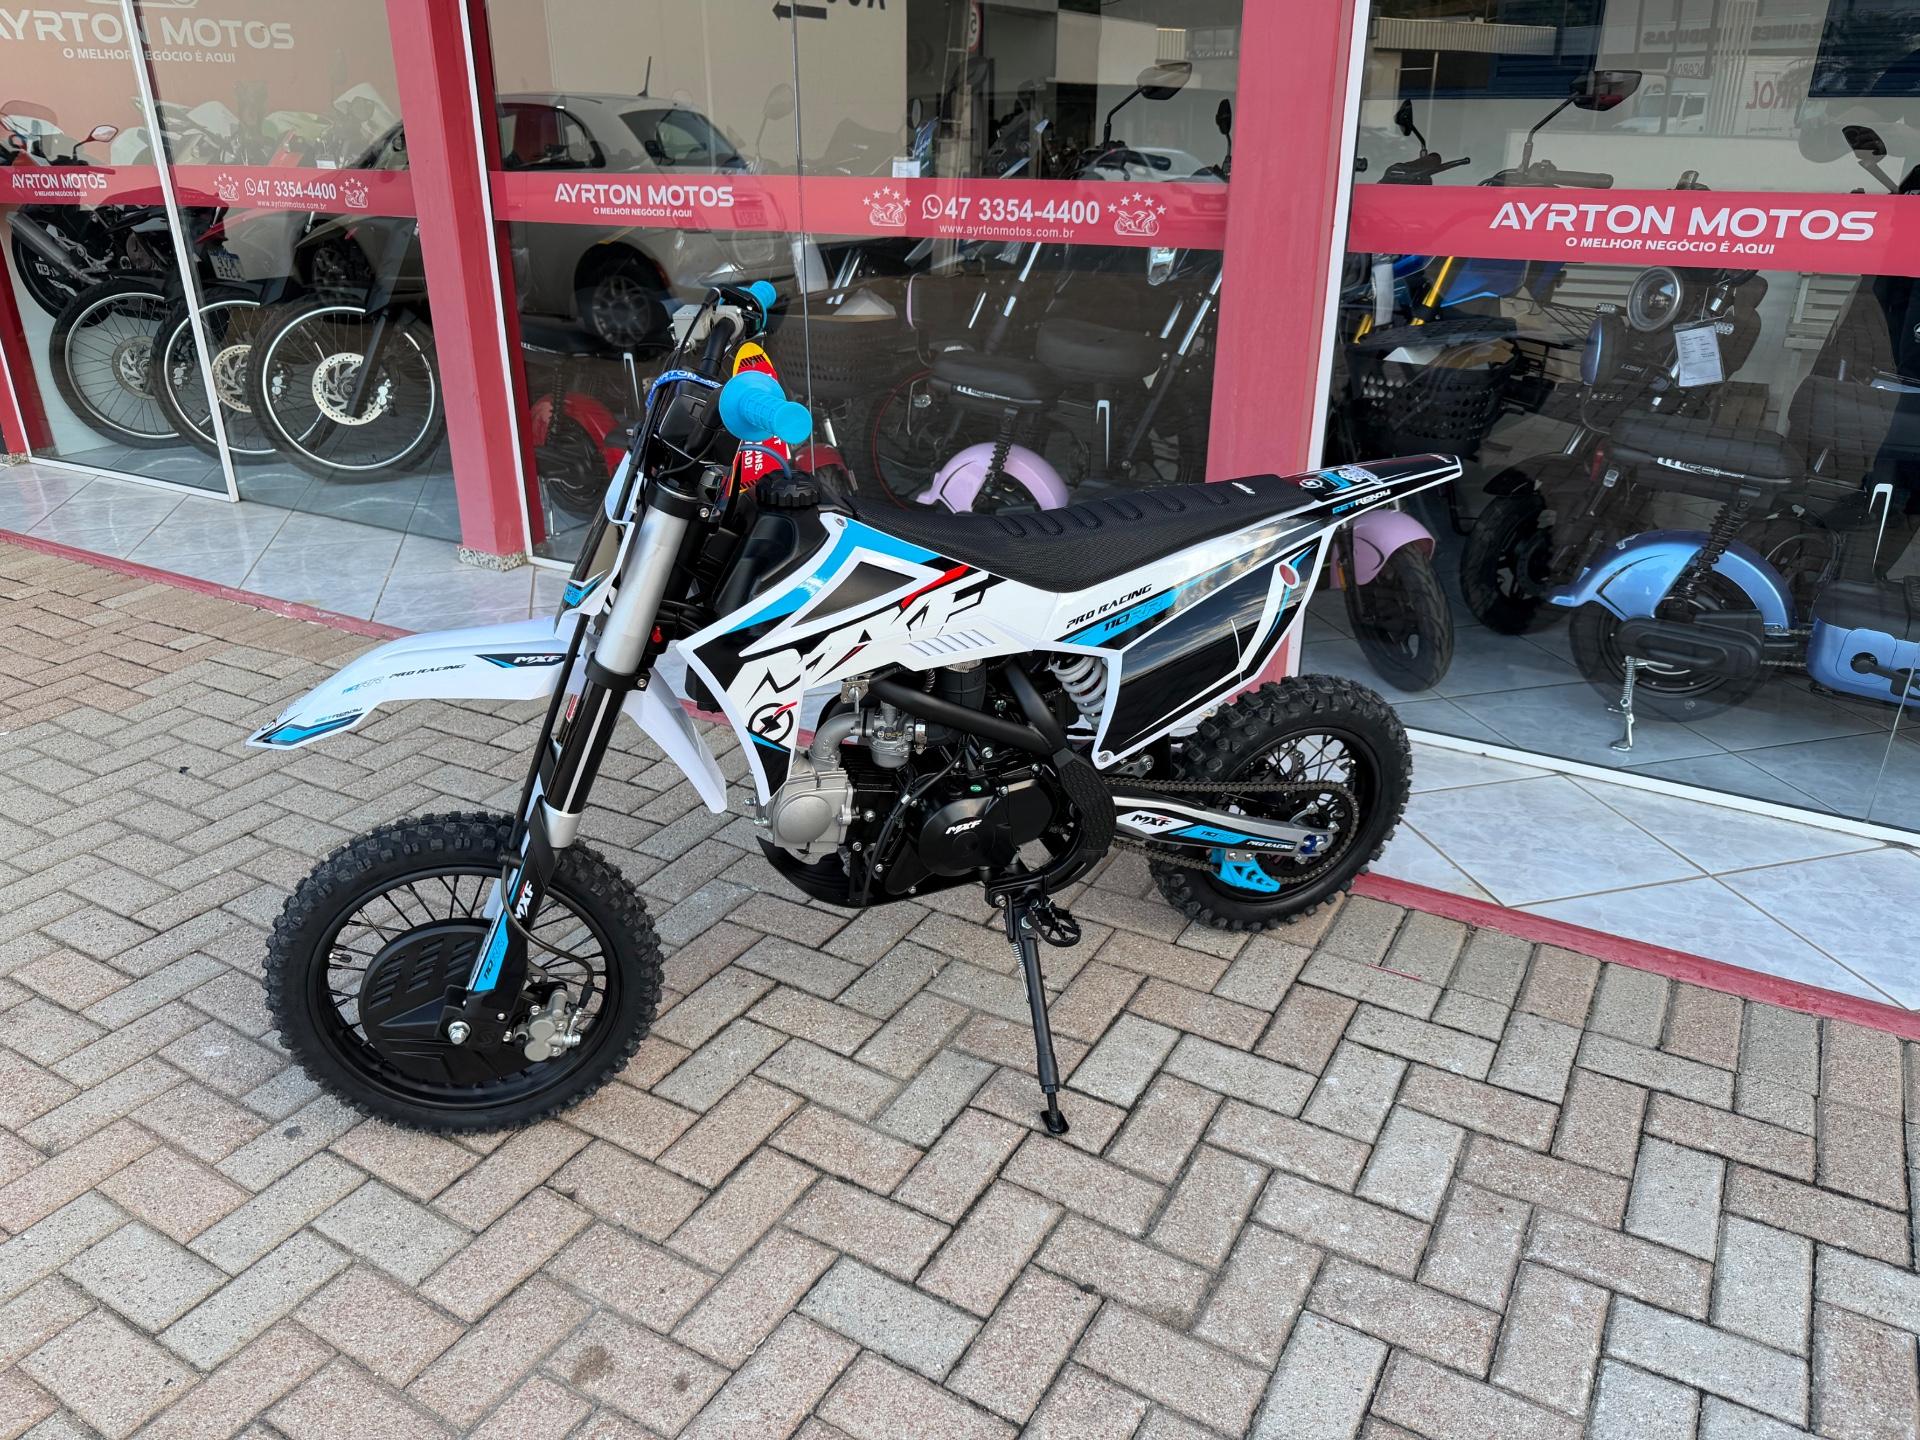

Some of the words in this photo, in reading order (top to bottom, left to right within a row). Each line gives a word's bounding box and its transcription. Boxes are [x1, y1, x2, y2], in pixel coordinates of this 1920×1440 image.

[159, 16, 295, 49] MOTOS
[62, 48, 74, 59] O
[195, 51, 203, 62] É
[205, 53, 236, 63] AQUI
[12, 173, 60, 189] AYRTON
[60, 174, 108, 189] MOTOS
[257, 179, 270, 197] 47
[273, 180, 337, 200] 3354-4400
[554, 183, 641, 206] AYRTON
[648, 185, 735, 207] MOTOS
[593, 206, 600, 215] O
[600, 207, 631, 216] MELHOR
[631, 207, 665, 217] NEGÓCIO
[666, 208, 672, 217] É
[672, 210, 693, 218] AQUI
[944, 197, 971, 220] 47
[978, 198, 1100, 225] 3354-4400
[939, 223, 1075, 238] www.ayrtonmotos.com.br
[1489, 202, 1676, 235] AYRTON
[1687, 206, 1878, 242] MOTOS
[1565, 237, 1579, 248] O
[1580, 238, 1642, 250] MELHOR
[1645, 237, 1717, 253] NEGÓCIO
[1719, 241, 1730, 253] É
[1733, 243, 1775, 255] AQUI
[1066, 609, 1096, 629] PRO
[1098, 583, 1153, 614] RACING
[513, 654, 562, 665] MXF
[945, 819, 983, 835] MXF
[1131, 813, 1173, 827] MXF
